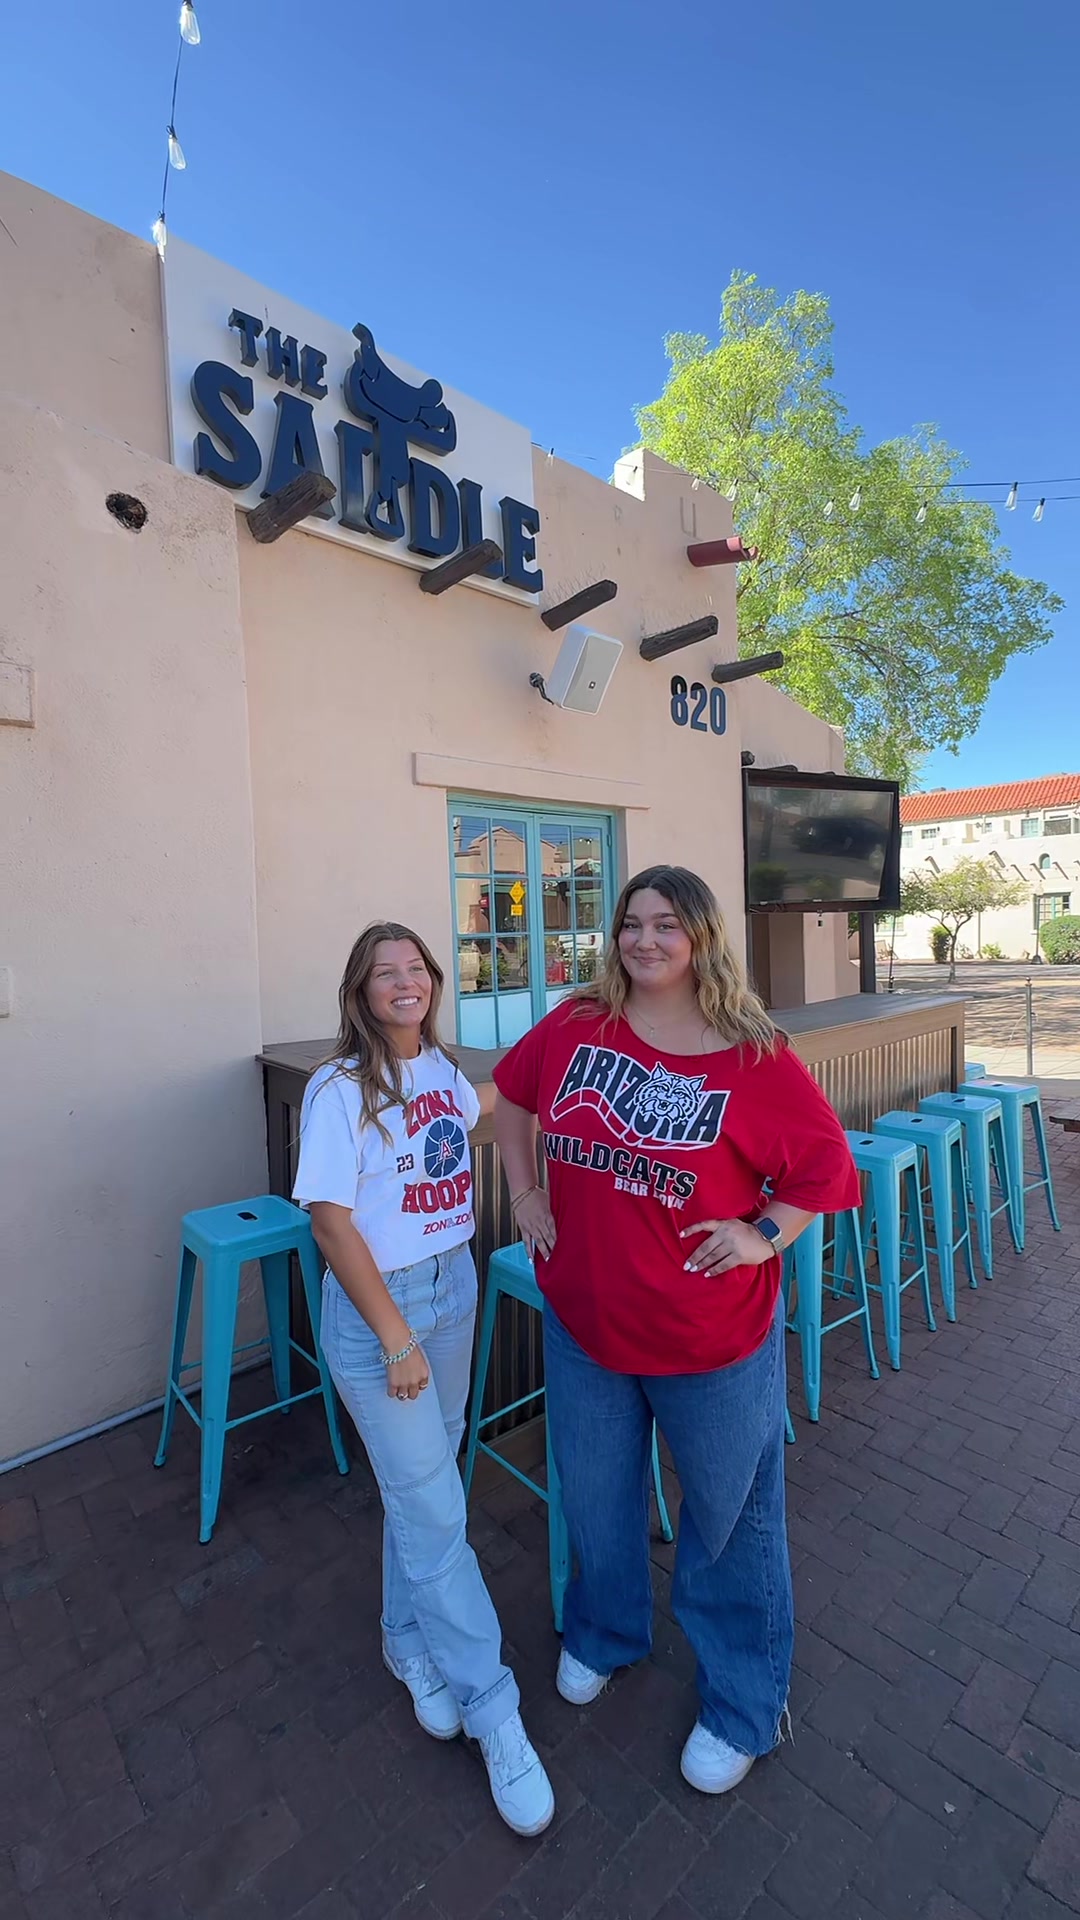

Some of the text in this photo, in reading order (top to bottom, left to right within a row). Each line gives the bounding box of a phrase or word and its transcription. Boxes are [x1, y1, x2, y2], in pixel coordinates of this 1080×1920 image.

[227, 308, 329, 401] THE
[190, 360, 544, 594] SADDLE
[670, 674, 727, 736] 820
[396, 1153, 415, 1174] 23
[543, 1131, 698, 1200] WILDCATS
[614, 1176, 649, 1197] BEAR
